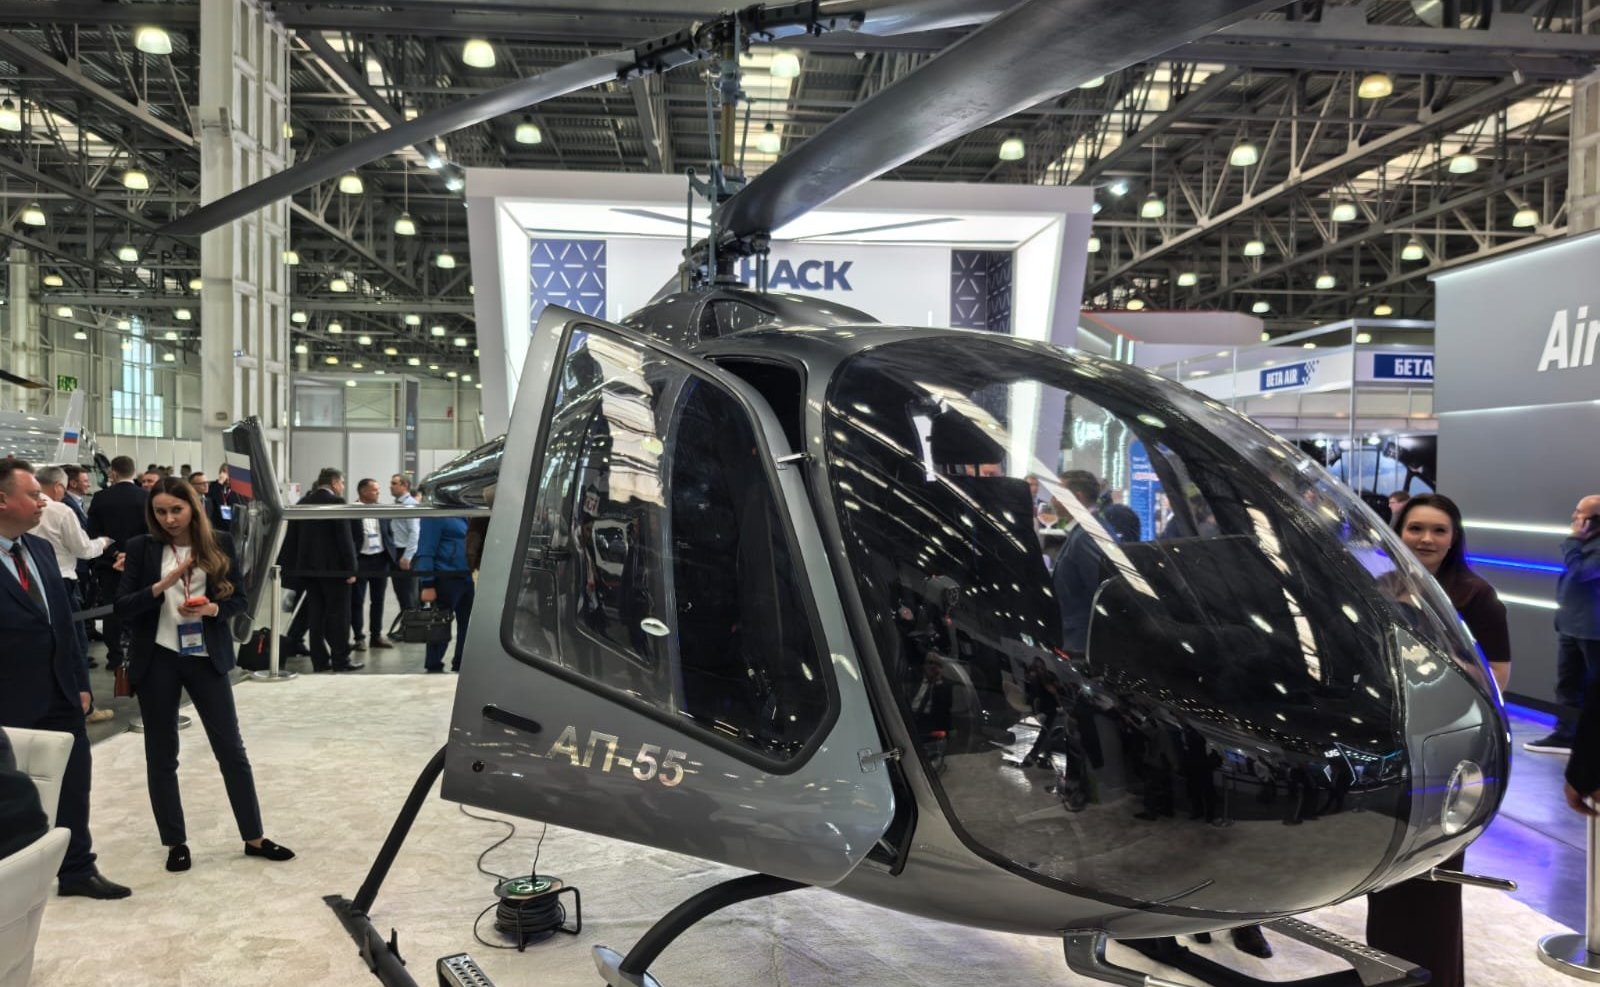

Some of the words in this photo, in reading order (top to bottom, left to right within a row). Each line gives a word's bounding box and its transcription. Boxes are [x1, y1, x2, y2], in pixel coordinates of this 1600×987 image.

[1537, 305, 1600, 371] Air
[1284, 368, 1298, 385] AIR
[1394, 358, 1434, 377] БЕТА
[549, 725, 687, 787] АП-55
